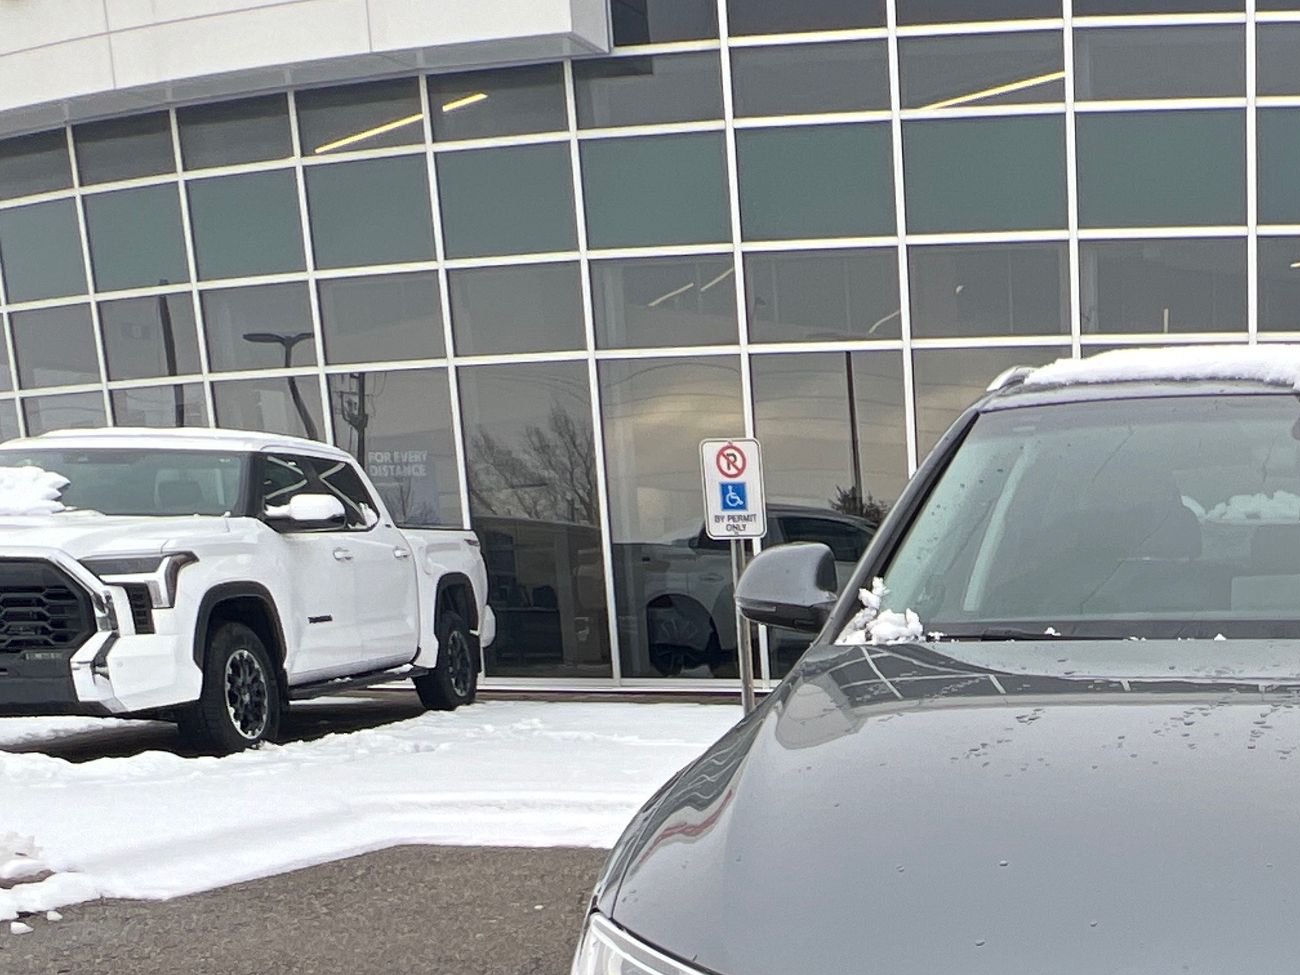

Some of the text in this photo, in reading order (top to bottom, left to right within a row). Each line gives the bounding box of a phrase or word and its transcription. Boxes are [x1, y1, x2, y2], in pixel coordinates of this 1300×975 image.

[368, 450, 428, 463] FOR EVERY
[369, 464, 427, 477] DISTANCE
[714, 514, 756, 523] BY PERMIT
[726, 524, 746, 532] ONLY
